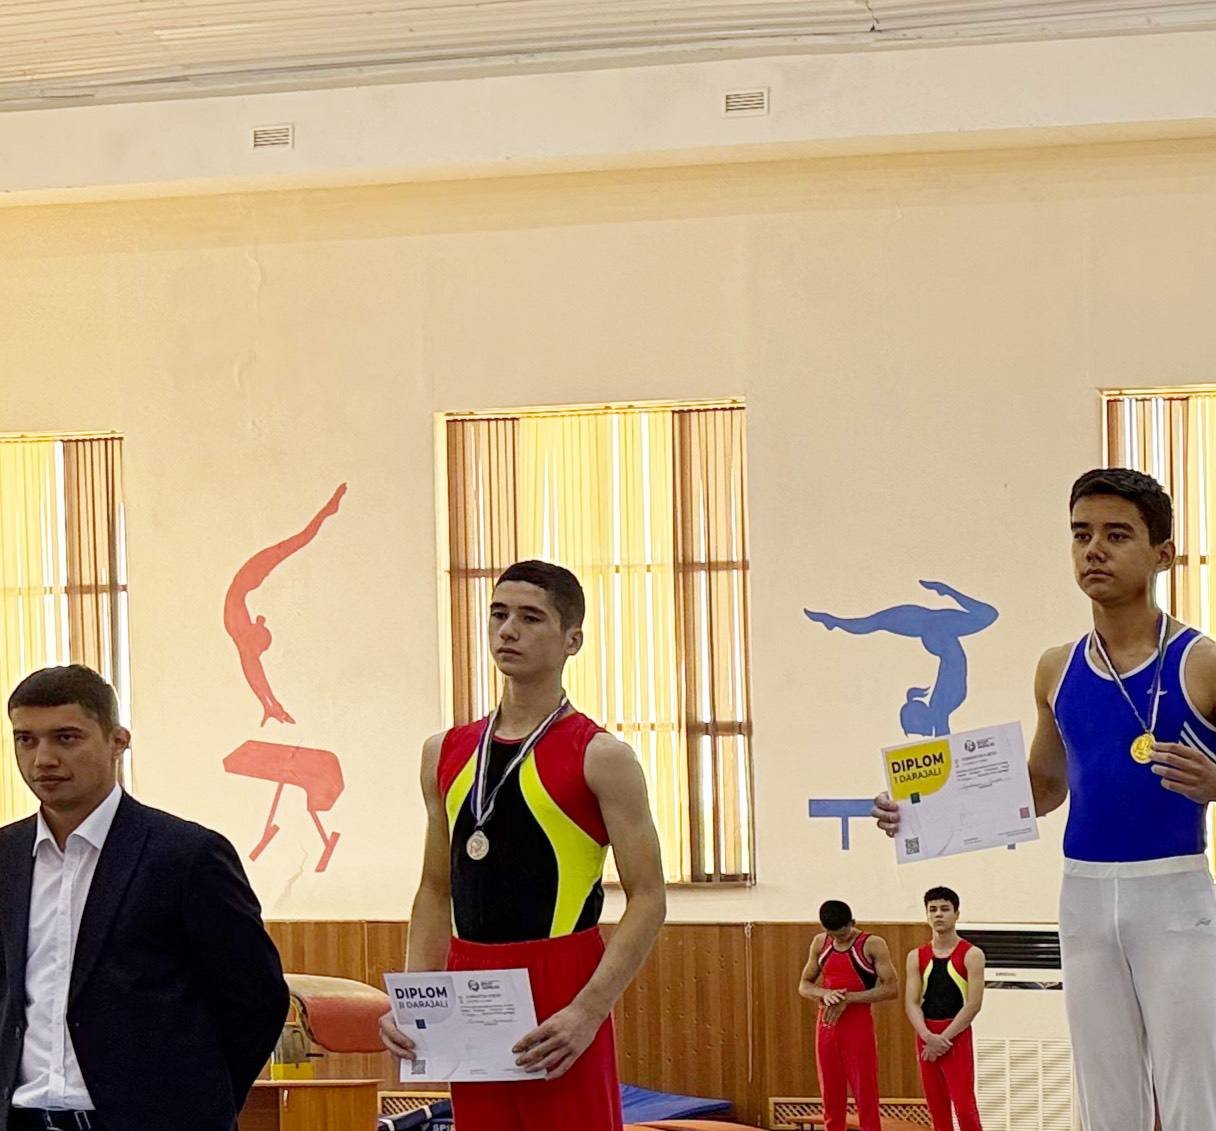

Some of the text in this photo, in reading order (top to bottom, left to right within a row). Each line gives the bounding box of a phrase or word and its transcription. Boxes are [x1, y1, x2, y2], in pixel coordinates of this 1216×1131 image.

[891, 752, 944, 774] DIPLOM
[899, 767, 942, 783] DARAJALI
[394, 986, 447, 1000] DIPLOM
[406, 1000, 448, 1009] DARAJALI
